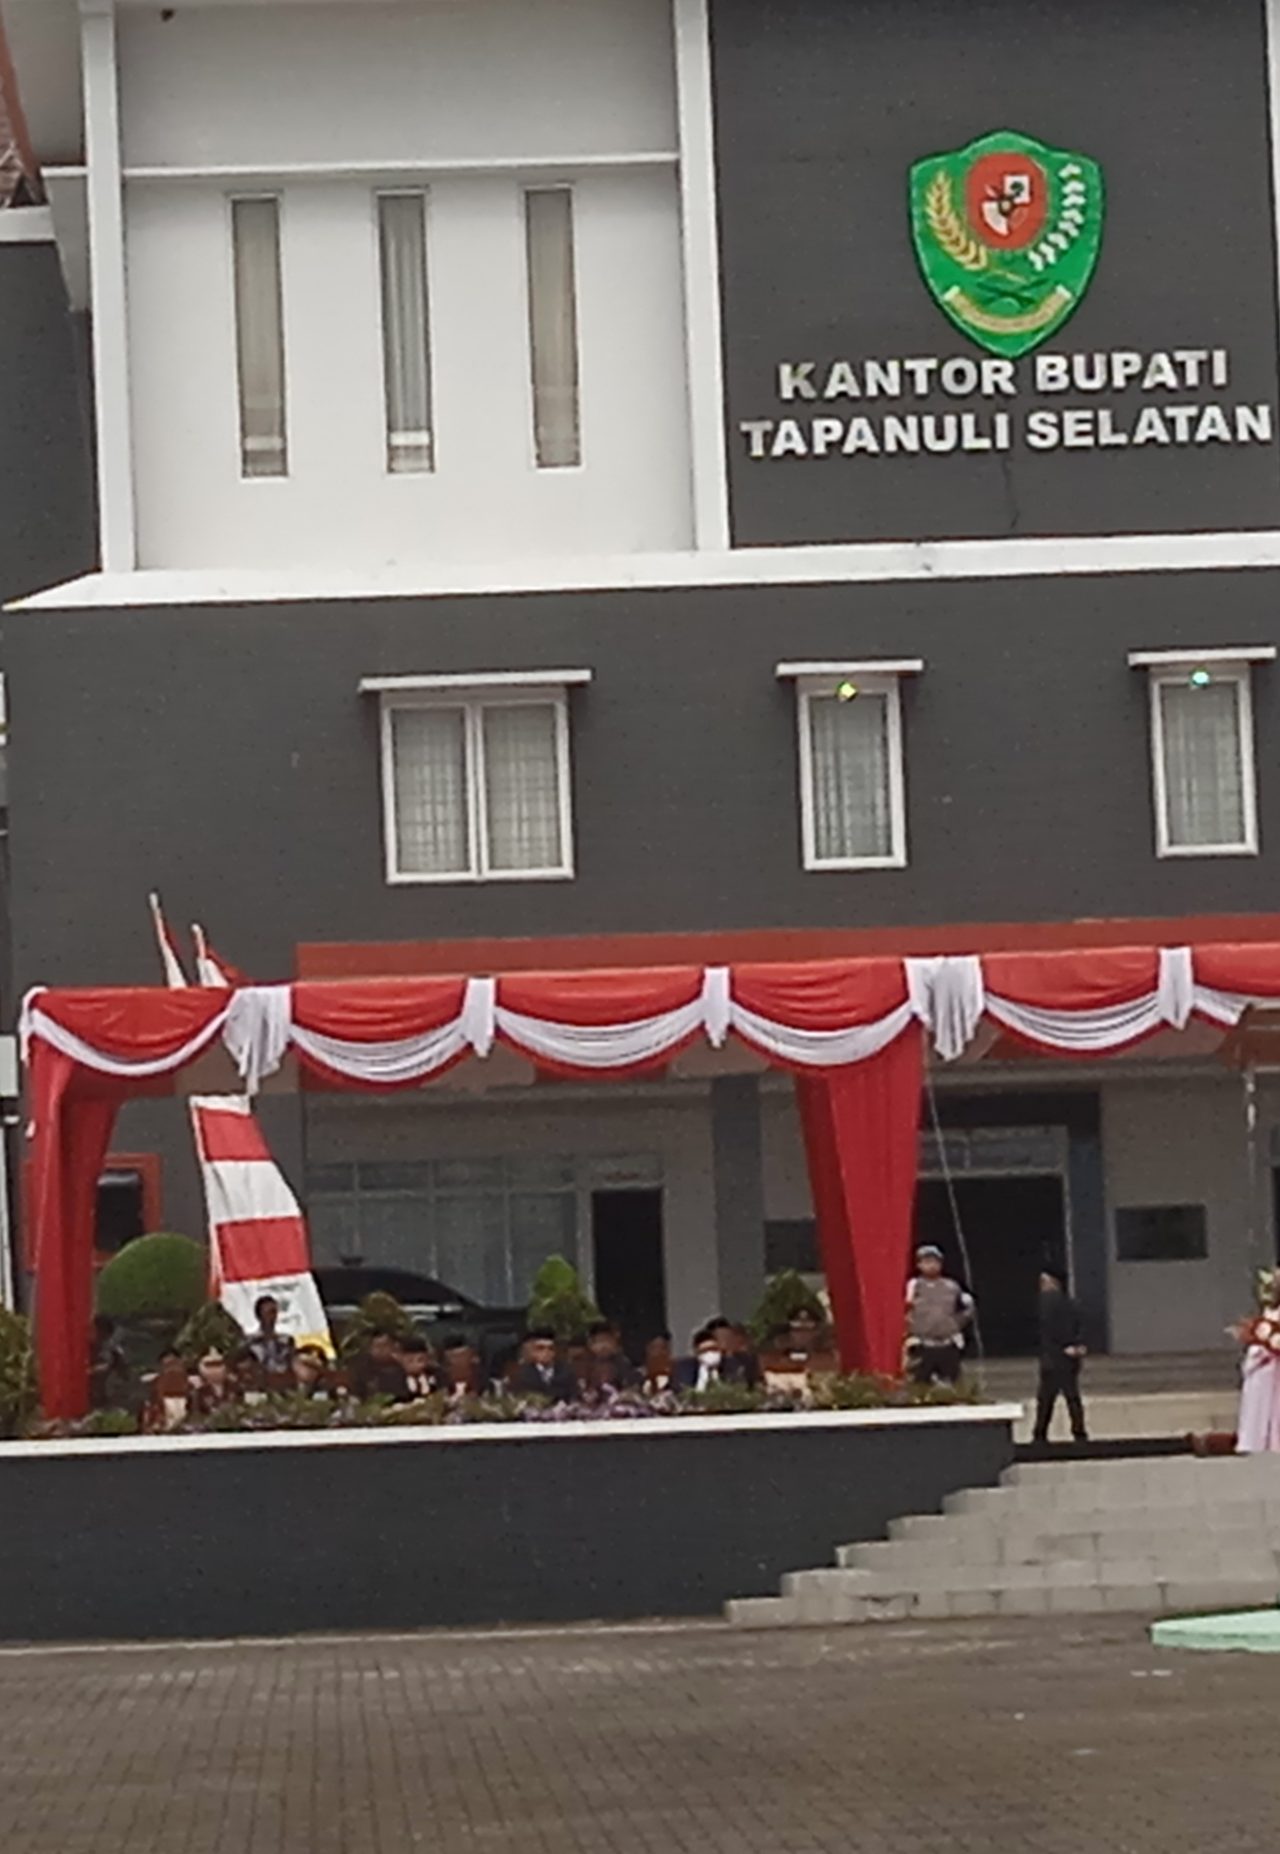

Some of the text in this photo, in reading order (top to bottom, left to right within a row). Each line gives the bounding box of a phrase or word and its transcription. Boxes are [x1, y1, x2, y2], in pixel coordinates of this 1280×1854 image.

[779, 349, 1227, 399] KANTOR BUPATI
[739, 404, 1272, 457] TAPANULI SELATAN
